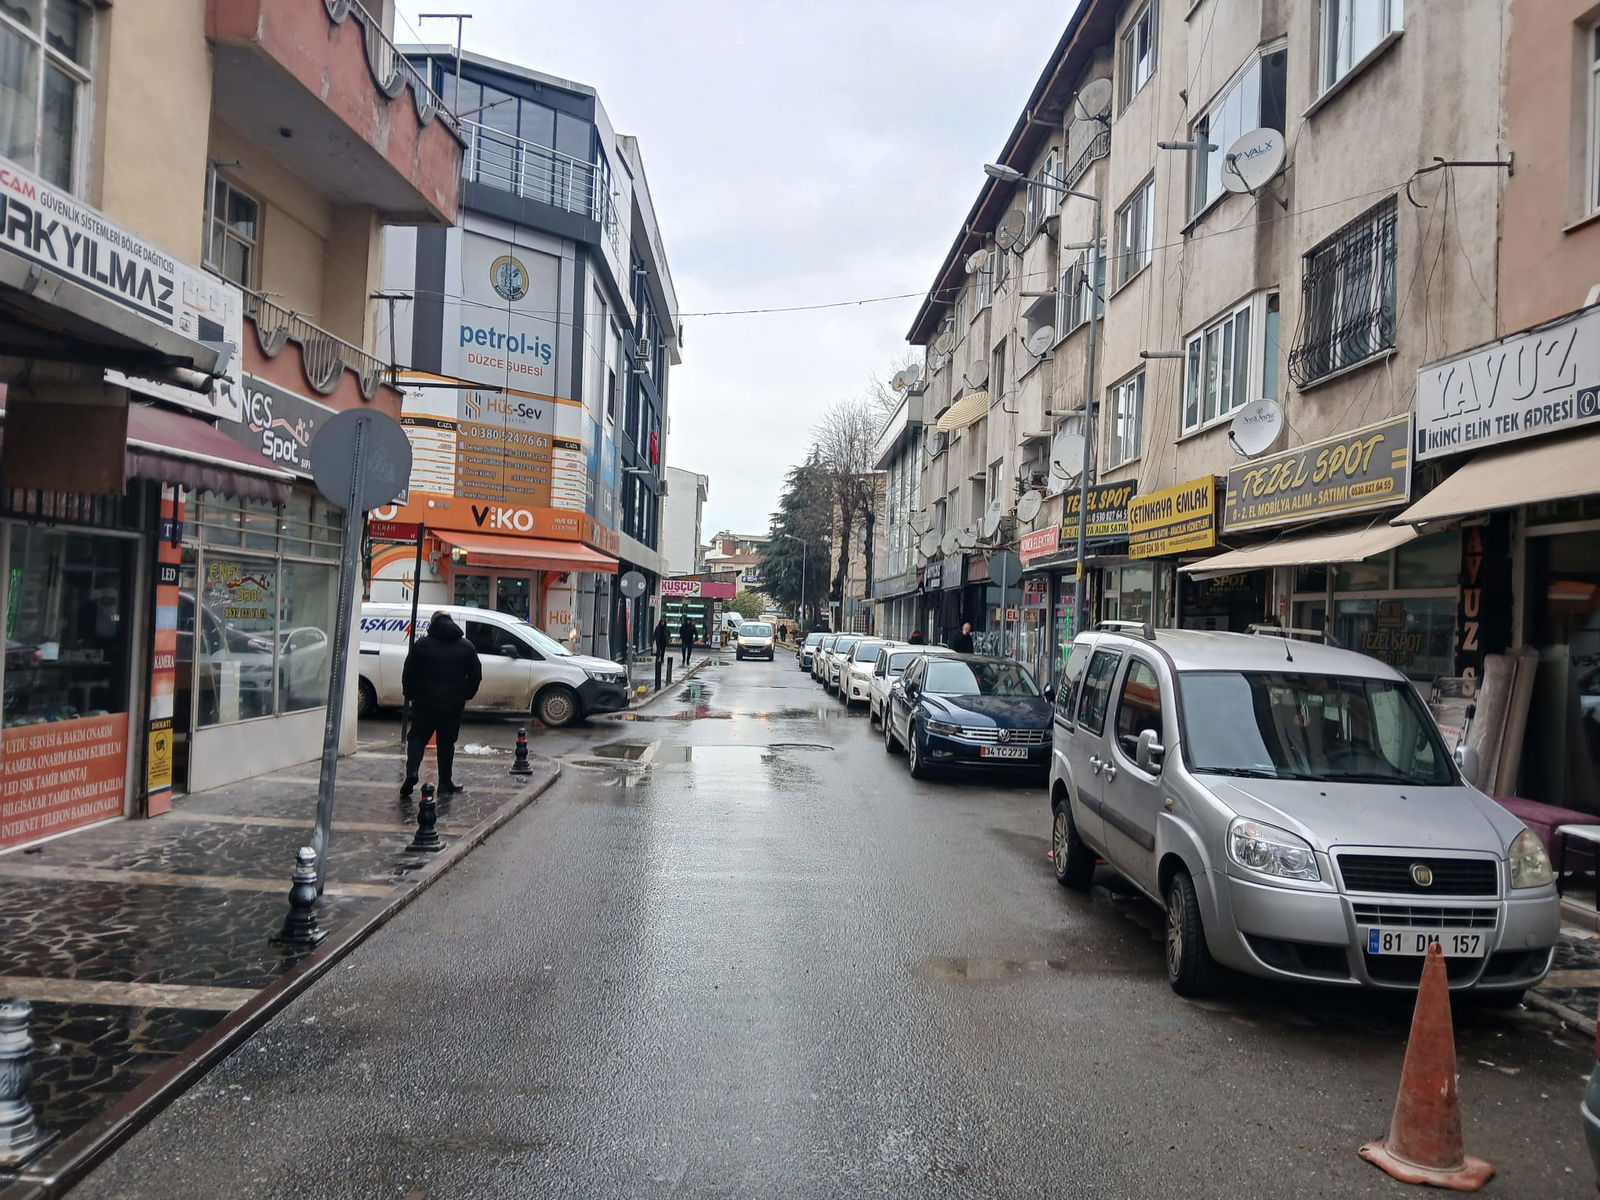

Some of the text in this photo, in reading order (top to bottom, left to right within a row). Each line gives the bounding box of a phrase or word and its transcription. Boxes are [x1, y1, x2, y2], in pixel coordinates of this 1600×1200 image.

[40, 191, 80, 224] GÜVENLİK
[81, 213, 120, 246] SİSTEMLERİ
[121, 236, 142, 257] BÖLGE
[143, 248, 174, 275] DAĞITICISI
[460, 325, 552, 365] petrol-iş
[468, 353, 504, 368] DÜZCE
[1430, 327, 1578, 422] YAVUZ
[487, 398, 542, 419] Hüs-Sev
[1428, 423, 1461, 450] İKİNCİ
[1465, 417, 1491, 441] ELİN
[1495, 412, 1519, 435] TEK
[1524, 395, 1573, 430] ADRESİ
[262, 430, 298, 464] Spot
[471, 427, 547, 448] 0 380 524 76 61
[1242, 434, 1385, 500] TEZEL SPOT
[1067, 486, 1132, 513] TEEL SPOT
[1130, 486, 1208, 531] ÇETİNKAYA EMLAK
[1232, 511, 1238, 521] 0
[1249, 507, 1257, 517] EL
[1258, 495, 1291, 516] MOBİLYA
[1292, 494, 1313, 508] ALIM
[1318, 485, 1348, 504] SATIMI
[1351, 485, 1364, 496] 0530
[1364, 483, 1375, 494] 827
[1376, 481, 1383, 492] 64
[1384, 480, 1392, 491] 55
[161, 567, 176, 581] LED
[661, 581, 693, 593] KUŞÇU
[1028, 583, 1047, 592] 2.EL
[1391, 633, 1425, 652] SPOT
[154, 654, 175, 668] KAMERA
[6, 738, 28, 754] UYDU
[56, 734, 62, 746] &
[64, 728, 86, 744] BAKIM
[86, 725, 113, 741] ONARIM
[986, 748, 1028, 757] 34 TC 2733
[5, 742, 121, 775] KAMERA ONARIM BAKIM KURULUM
[4, 780, 19, 796] LED
[36, 770, 59, 789] TAMİR
[59, 766, 88, 784] MONTAJ
[3, 776, 124, 817] BİLGİSAYAR TAMİR ONARIM YAZILIM
[41, 808, 71, 828] TELEFON
[71, 803, 93, 820] BAKIM
[93, 796, 119, 813] ONARIM
[1383, 932, 1402, 951] 81
[1453, 935, 1480, 954] 157
